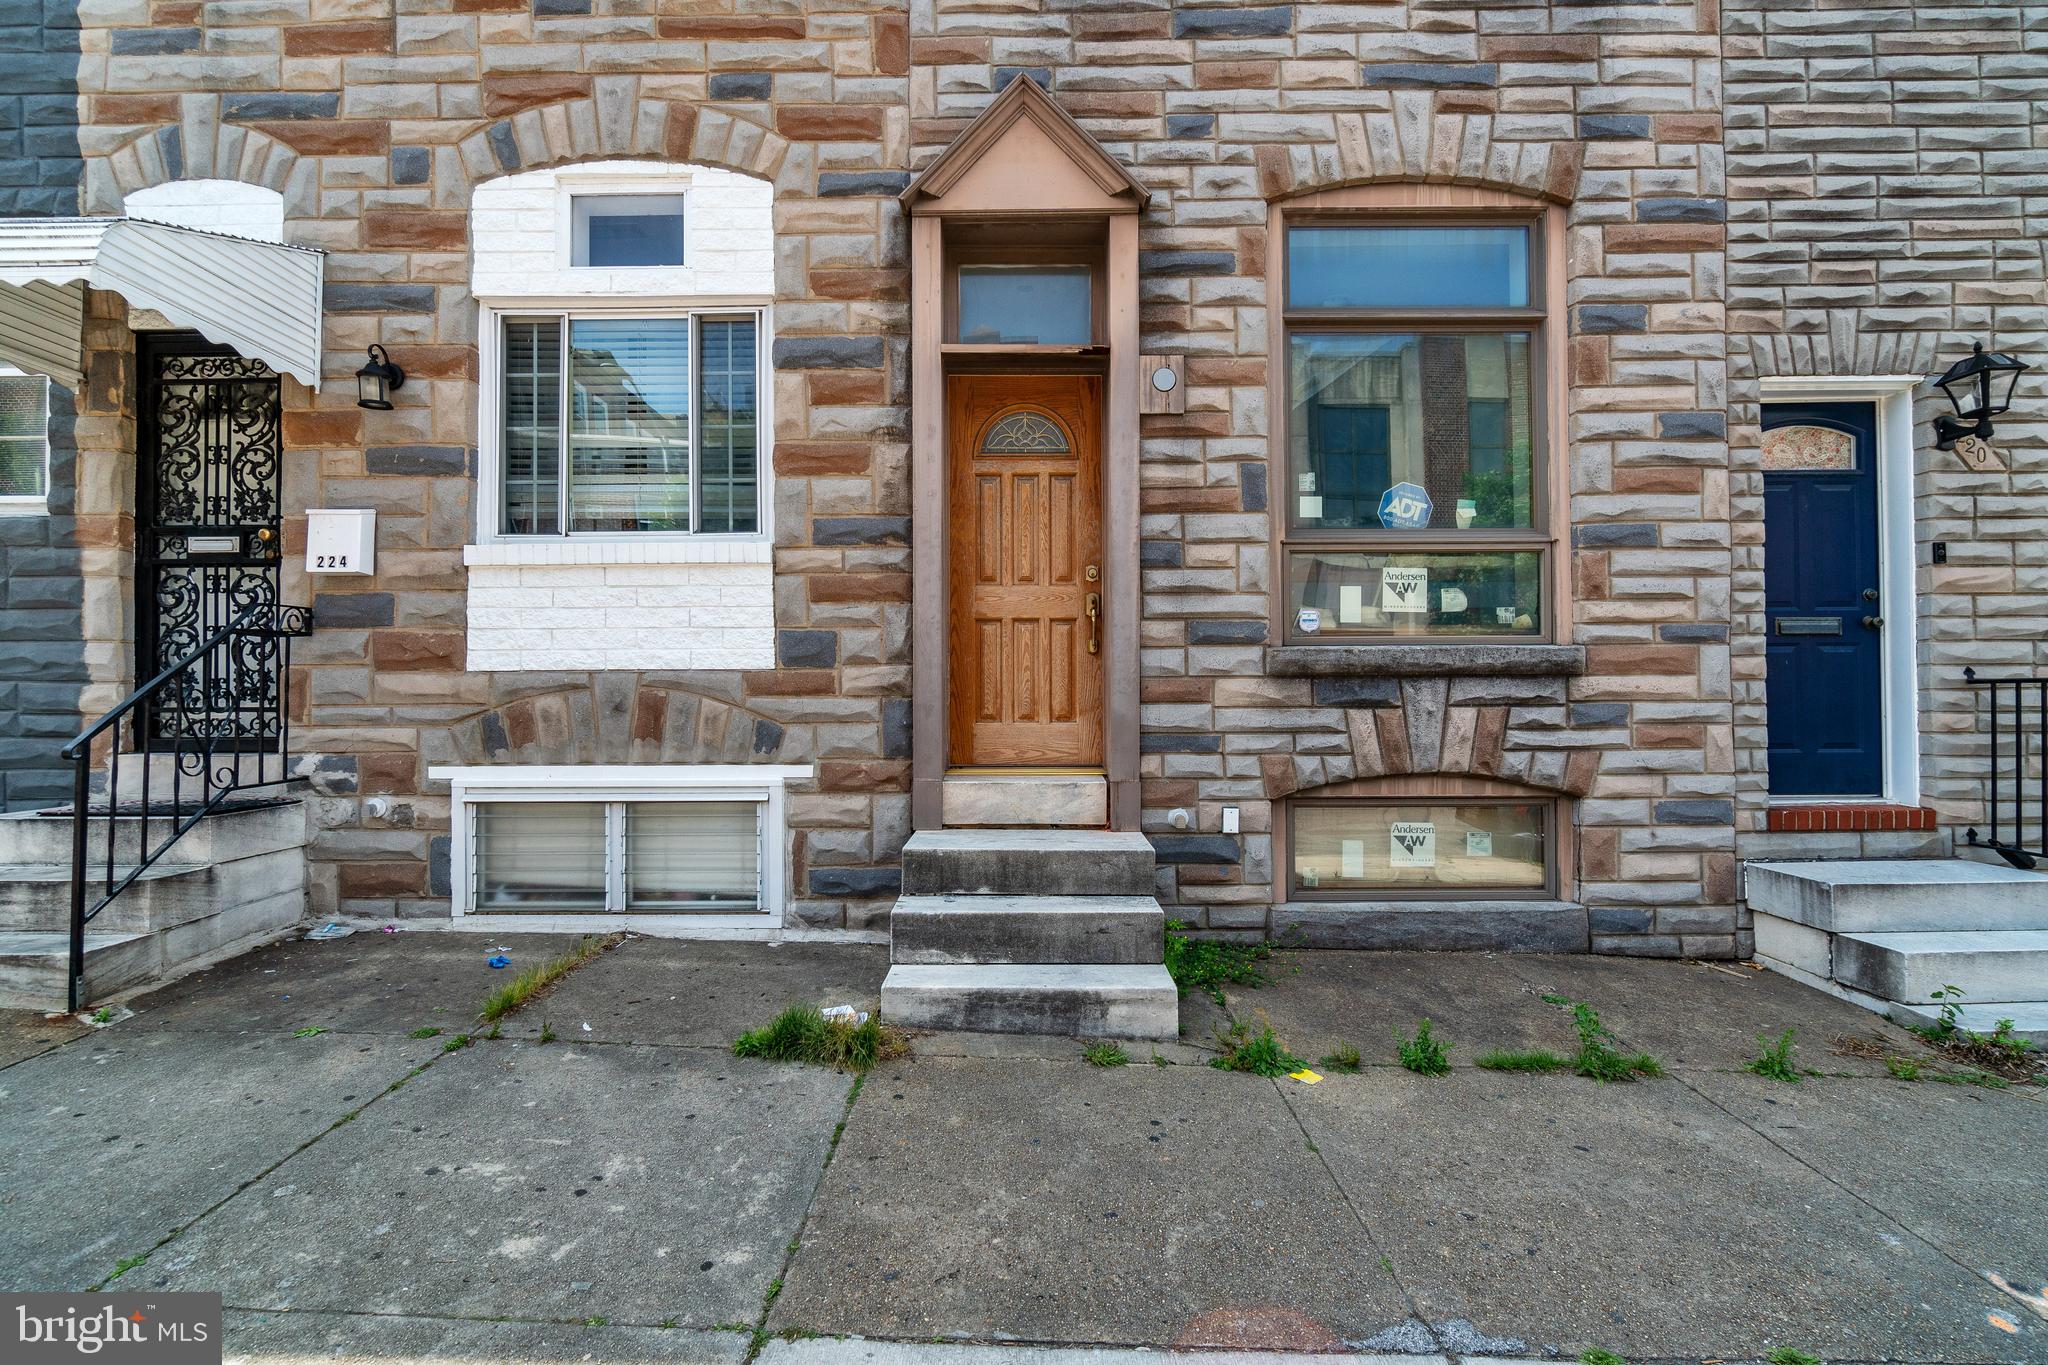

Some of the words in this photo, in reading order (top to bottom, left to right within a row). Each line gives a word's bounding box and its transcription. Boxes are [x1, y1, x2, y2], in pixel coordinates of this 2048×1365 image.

[1956, 438, 1986, 463] 20
[1383, 496, 1428, 521] ADT
[317, 555, 347, 568] 224
[1384, 571, 1426, 581] Andersen
[1392, 824, 1435, 834] Andersen
